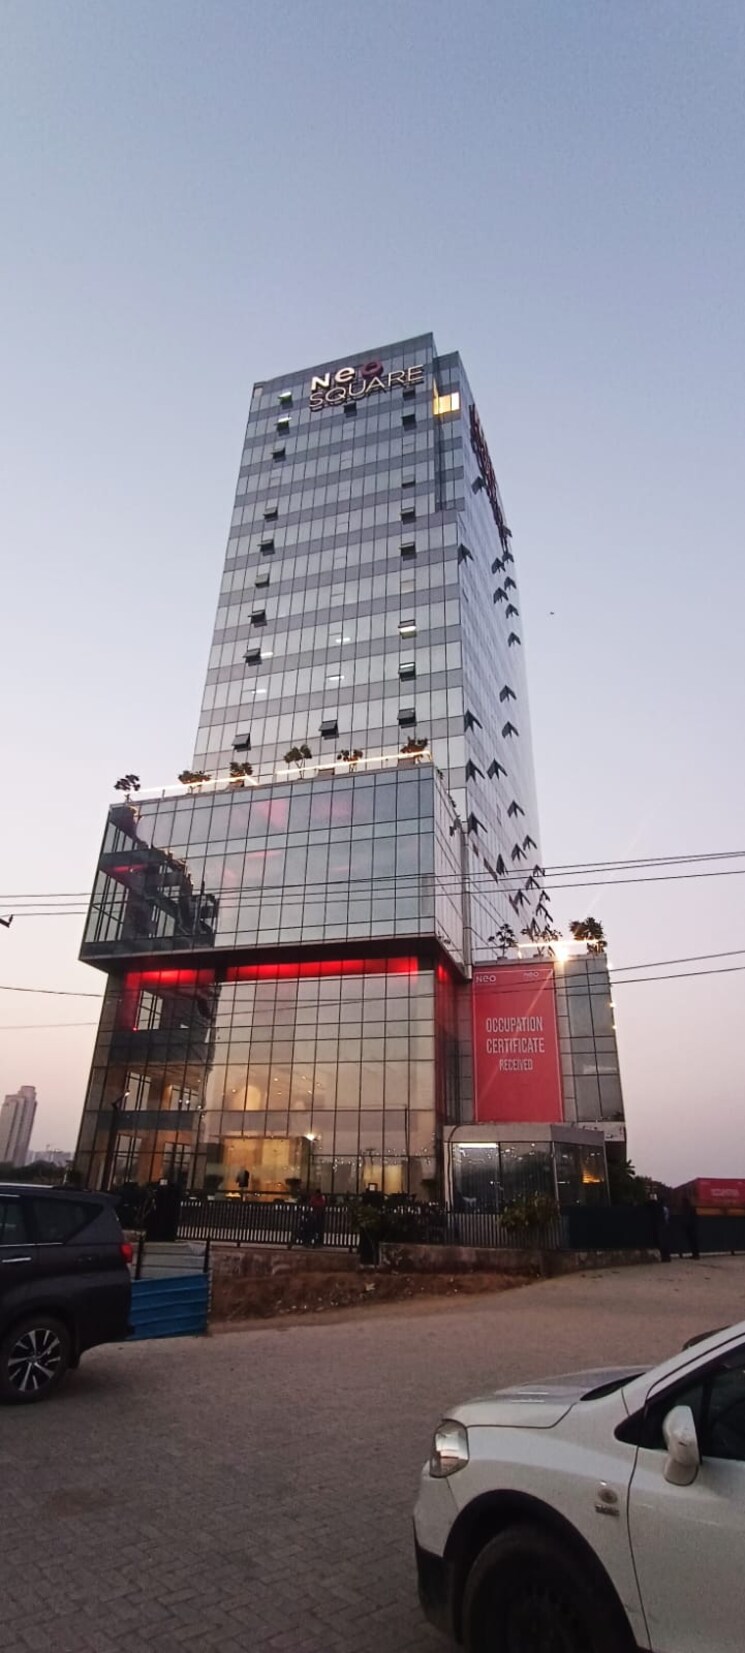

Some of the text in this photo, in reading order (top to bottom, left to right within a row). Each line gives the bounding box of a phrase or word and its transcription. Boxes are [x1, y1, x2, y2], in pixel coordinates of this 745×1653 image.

[309, 364, 424, 409] SQUARE
[485, 1016, 544, 1033] OCCUPATION
[486, 1037, 545, 1054] CERTIFICATE
[499, 1058, 534, 1071] RECEIVED
